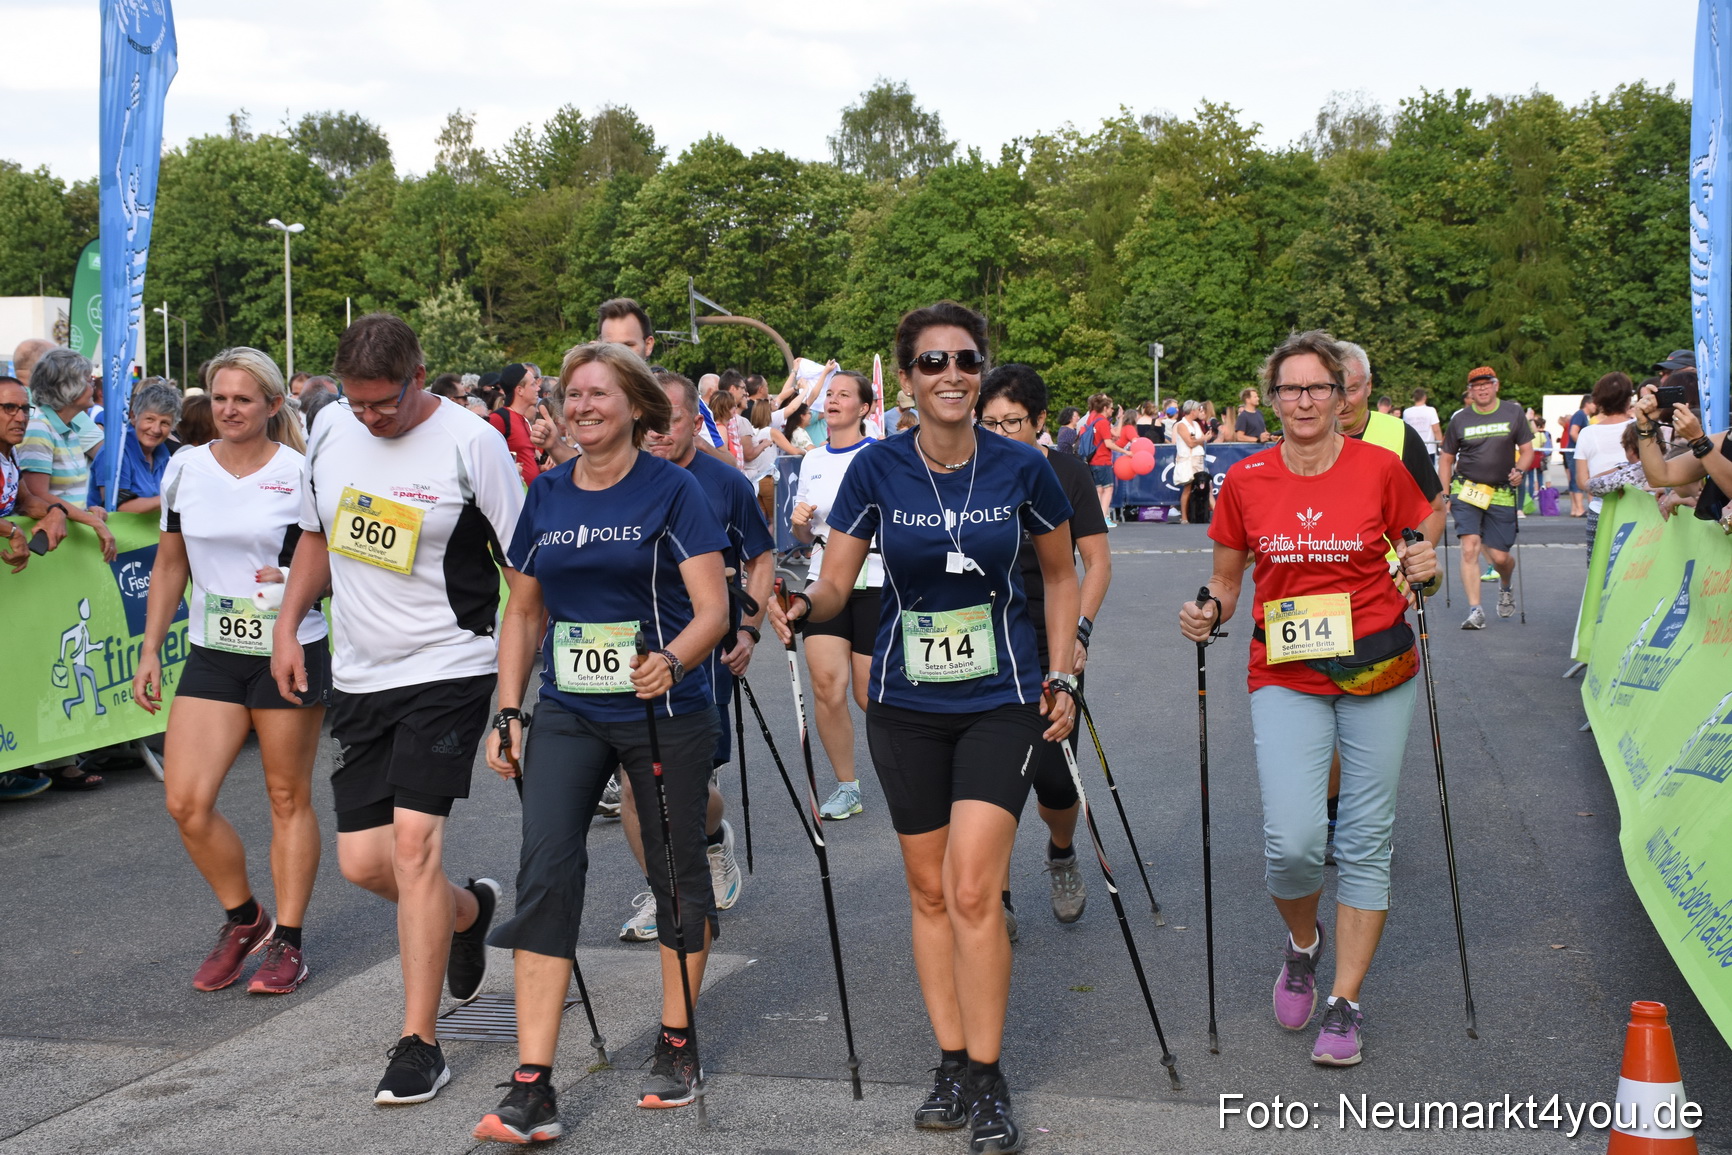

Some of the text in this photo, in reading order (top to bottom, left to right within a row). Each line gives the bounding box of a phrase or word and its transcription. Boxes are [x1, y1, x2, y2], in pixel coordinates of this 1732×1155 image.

[1464, 422, 1511, 438] BOCK
[413, 483, 431, 491] TEAM
[399, 491, 440, 501] partner
[893, 509, 942, 527] EURO
[960, 505, 1011, 525] POLES
[350, 516, 396, 550] 960
[538, 530, 575, 546] EURO
[590, 526, 642, 542] POLES
[367, 545, 387, 556] Oliver
[1259, 533, 1364, 553] Echtes Handwerk
[1270, 554, 1350, 564] IMMER FRISCH
[219, 616, 262, 640] 963
[970, 623, 987, 633] 2019
[1281, 617, 1332, 644] 614
[617, 640, 635, 648] 2019
[919, 633, 975, 662] 714
[1282, 640, 1335, 651] Sedlmeier Britta
[569, 648, 620, 673] 706
[949, 660, 974, 669] Sabine
[919, 669, 943, 677] Europoles
